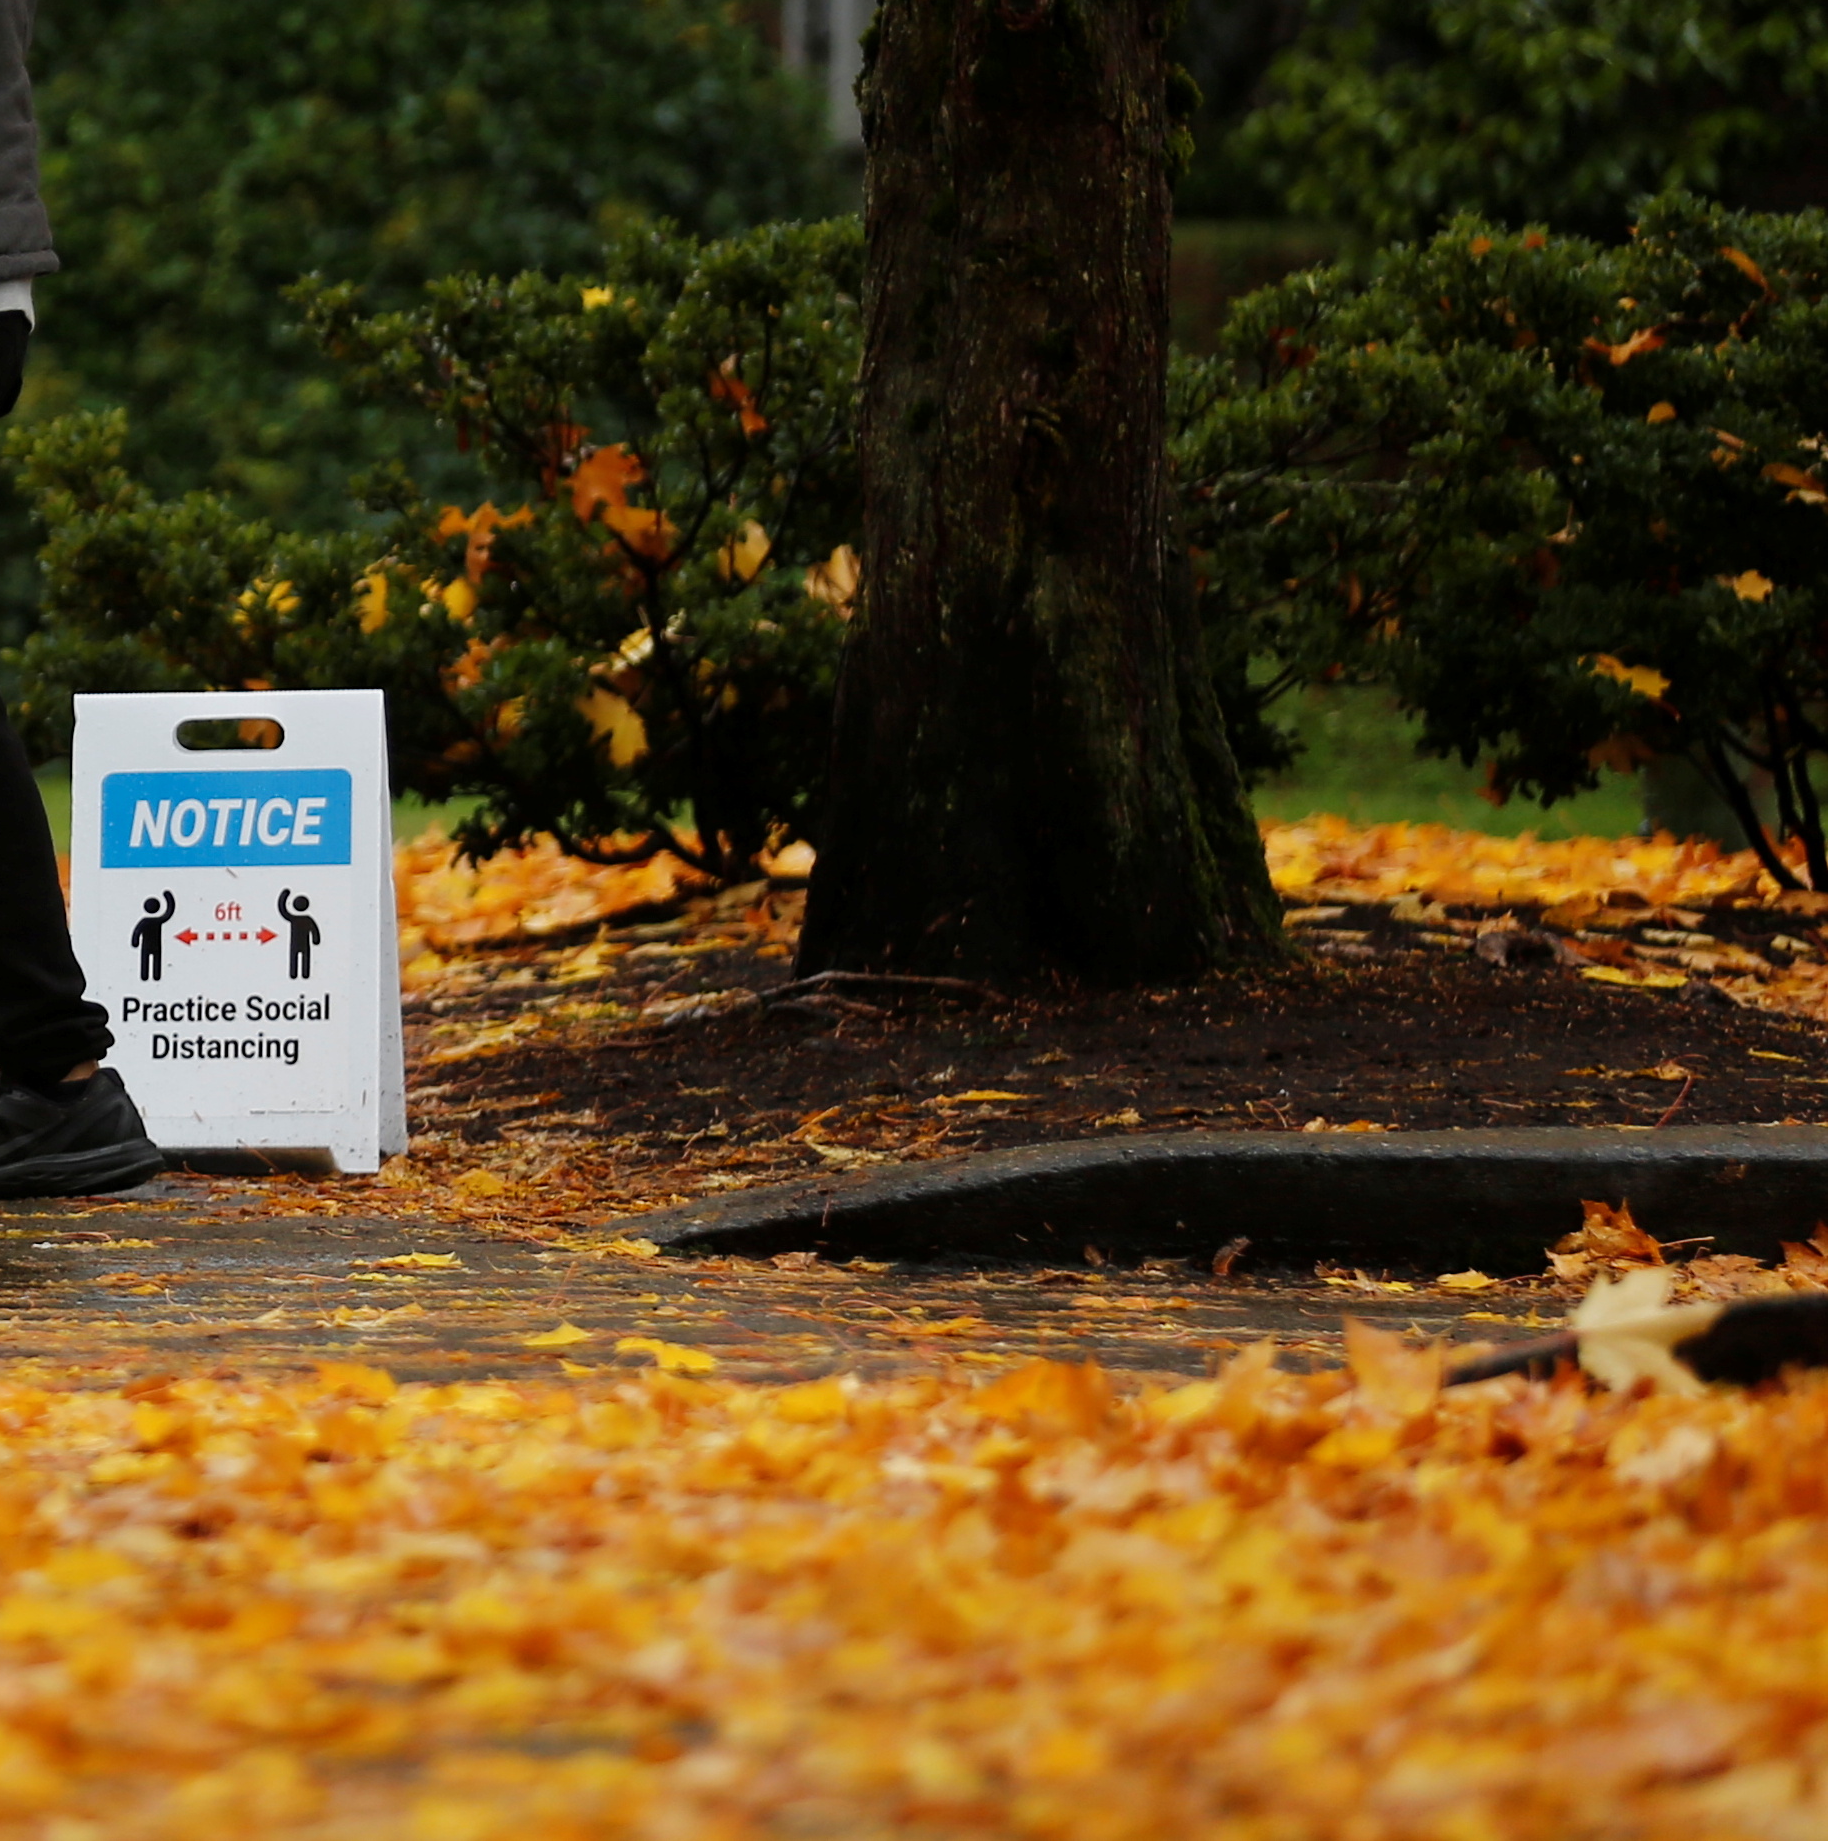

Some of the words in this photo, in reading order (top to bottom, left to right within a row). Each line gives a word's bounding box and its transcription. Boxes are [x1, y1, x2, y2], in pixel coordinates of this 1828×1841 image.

[129, 797, 326, 847] NOTICE
[214, 901, 242, 921] 6ft
[122, 995, 237, 1023] Practice
[246, 992, 330, 1022] Social
[151, 1031, 300, 1066] Distancing
